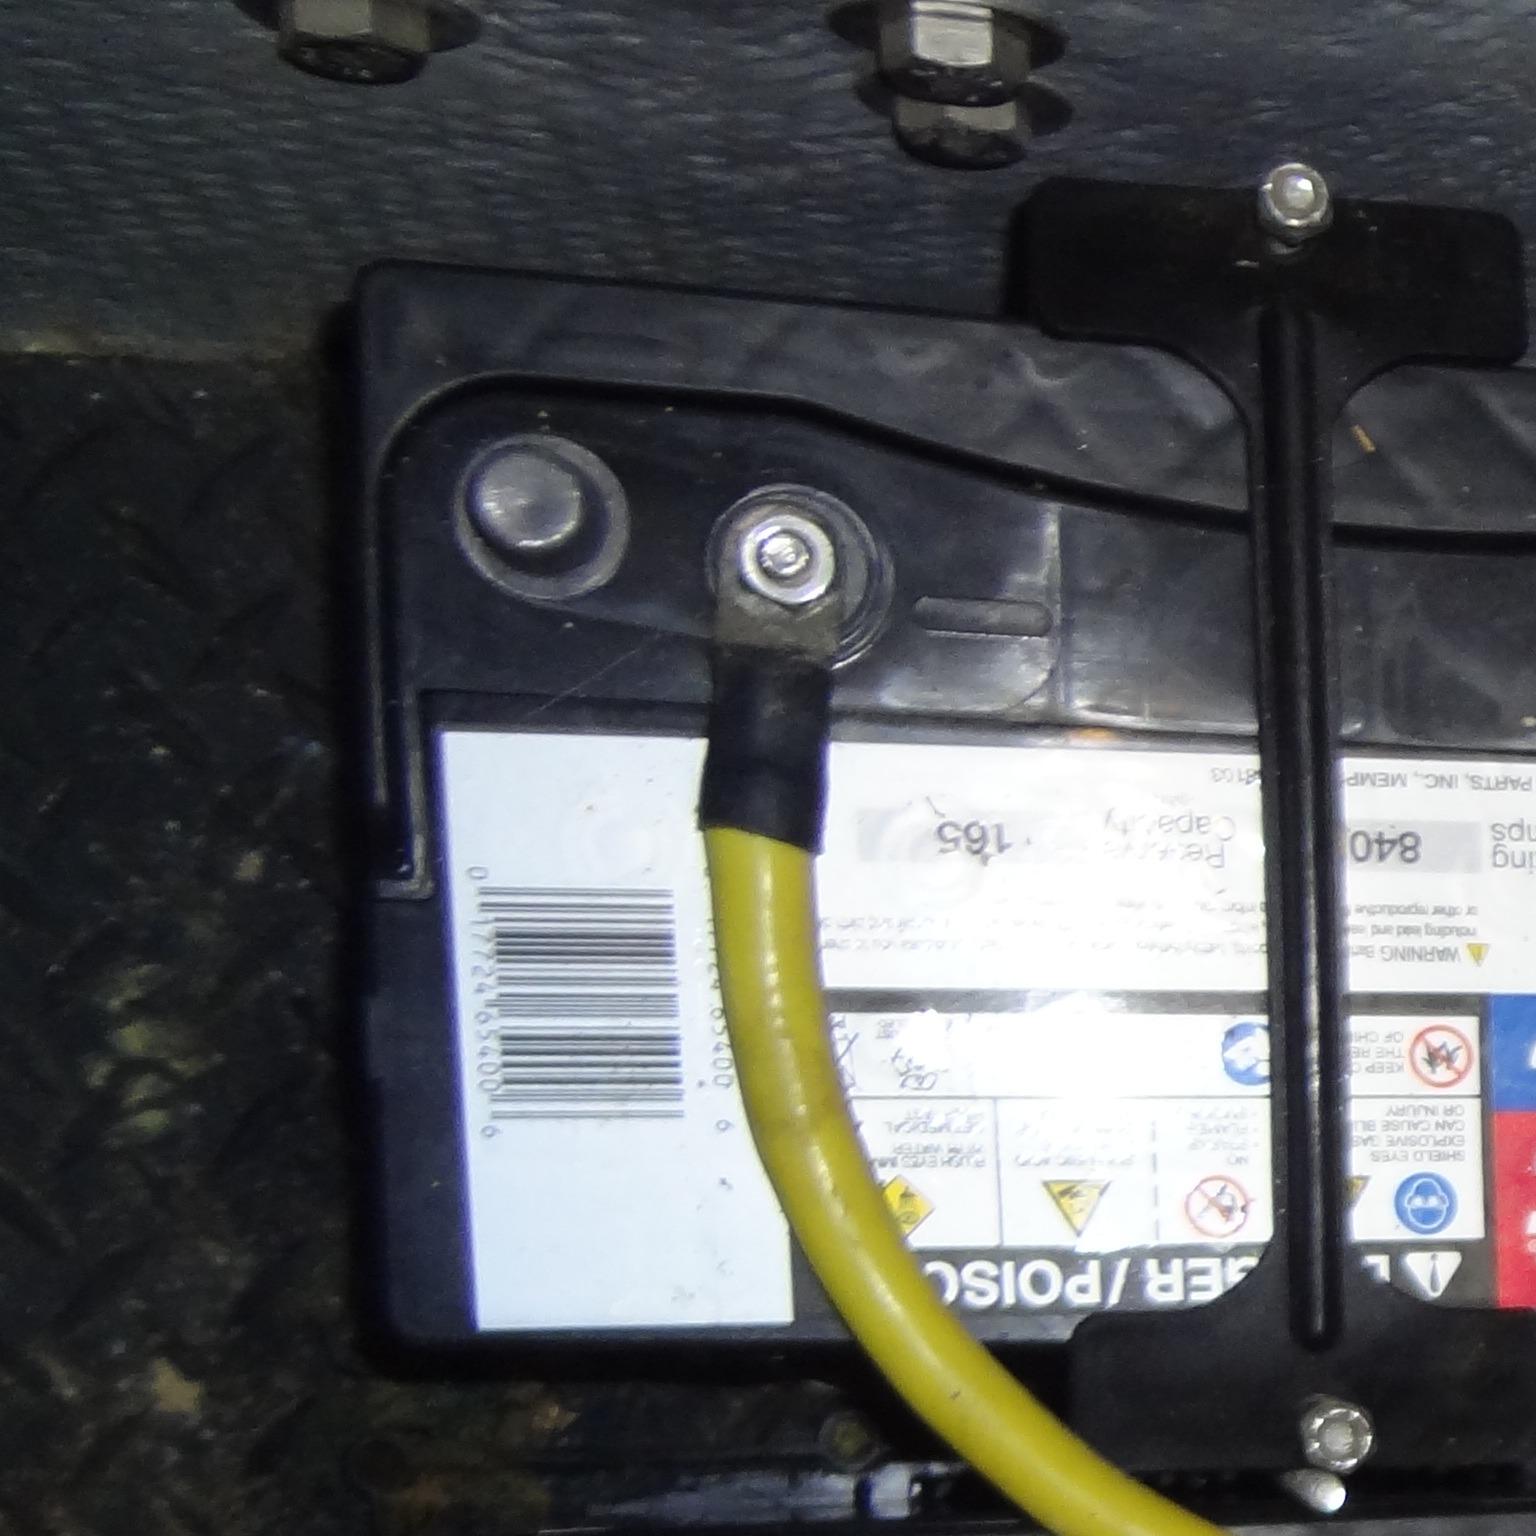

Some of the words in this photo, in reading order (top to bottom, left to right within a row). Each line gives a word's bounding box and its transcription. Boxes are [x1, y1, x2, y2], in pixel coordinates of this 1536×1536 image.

[936, 820, 1012, 855] 165
[1349, 830, 1421, 863] 840
[1381, 945, 1460, 962] WARNING
[924, 1258, 1130, 1306] /POIS
